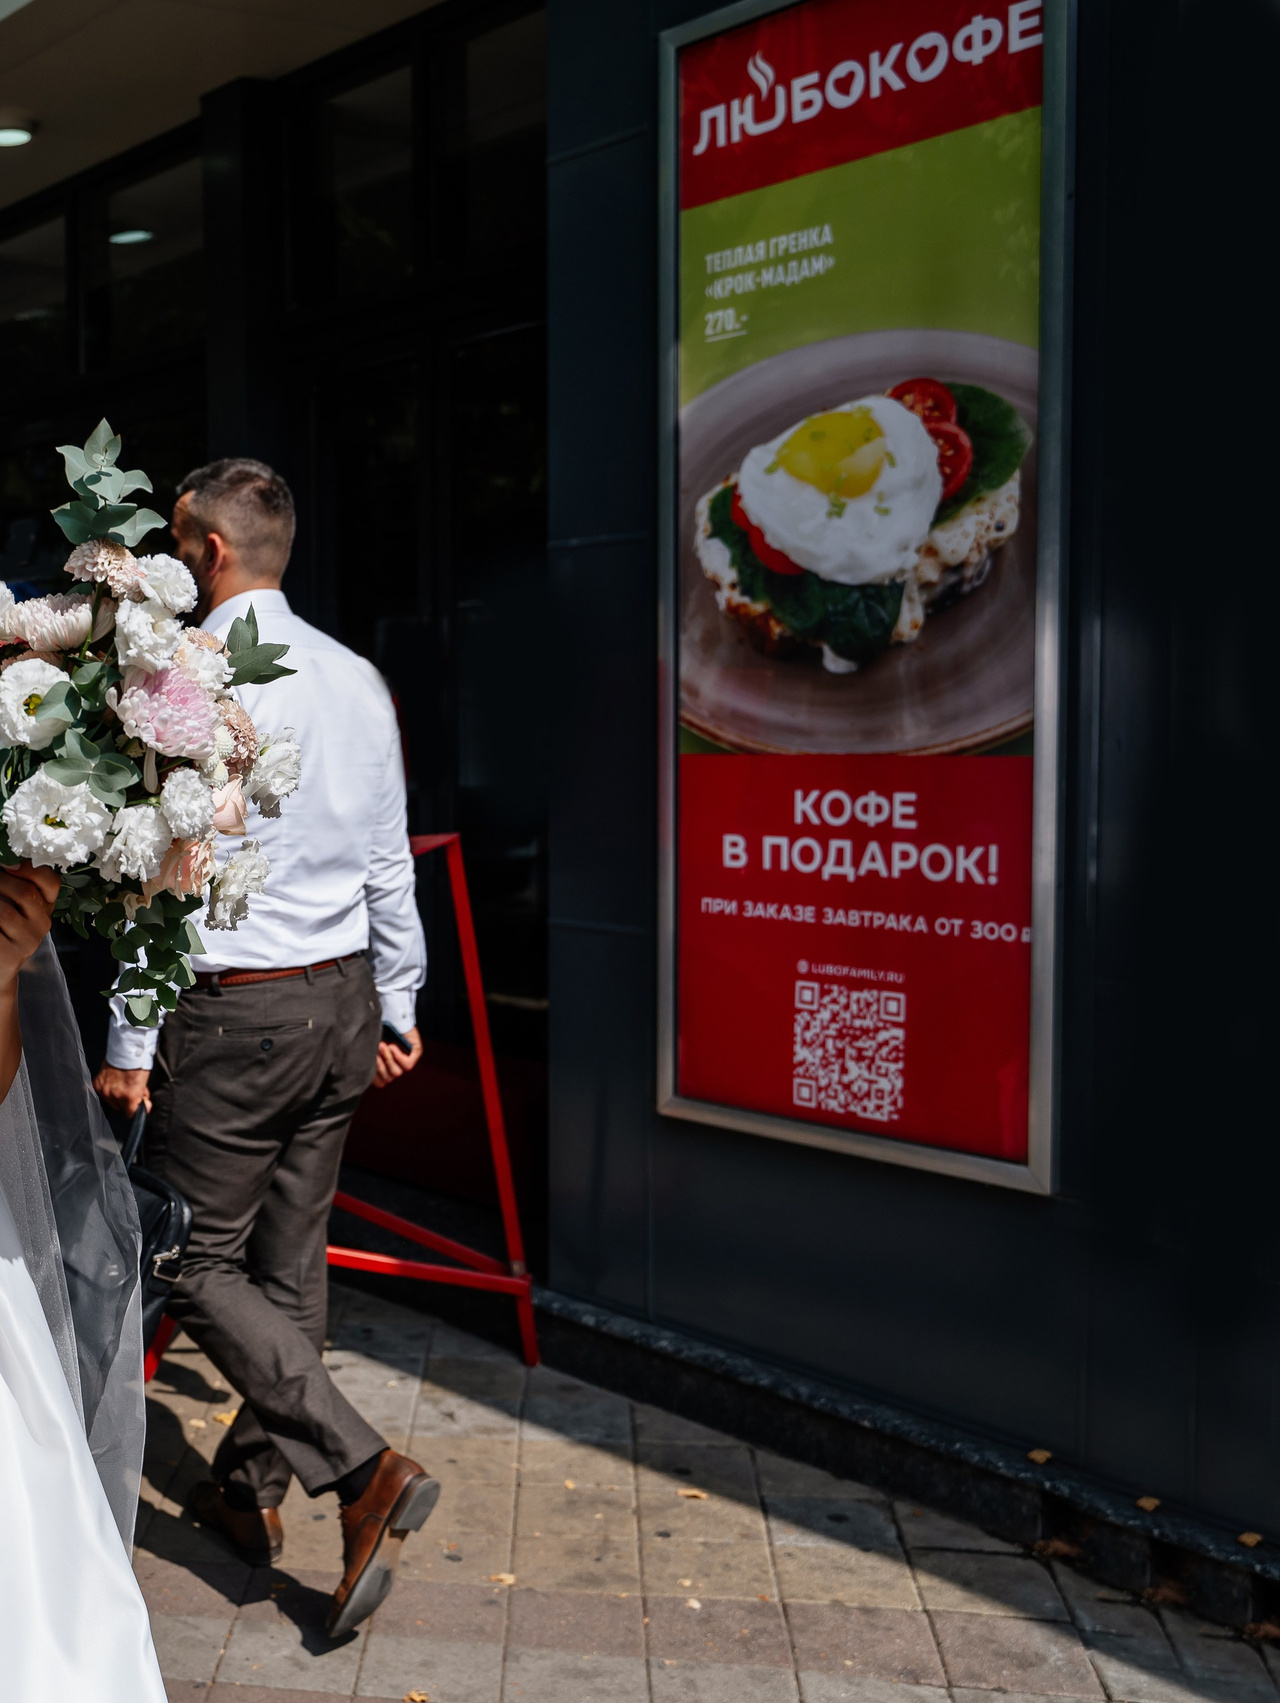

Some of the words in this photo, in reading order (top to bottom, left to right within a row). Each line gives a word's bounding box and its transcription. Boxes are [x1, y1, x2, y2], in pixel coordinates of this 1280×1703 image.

[692, 0, 1043, 156] ЛЮБОКОФЕ
[704, 240, 766, 275] ТЕПЛАЯ
[768, 223, 835, 260] ГРЕНКА
[704, 253, 836, 300] «КРОК-МАДАМ»
[793, 789, 918, 829] КОФЕ
[721, 833, 749, 869] В
[761, 835, 1000, 886] ПОДАРОК!
[700, 896, 739, 917] ПРИ
[742, 900, 817, 924] ЗАКАЗЕ
[821, 907, 929, 934] ЗАВТРАКА
[934, 916, 964, 938] ОТ
[969, 920, 1018, 943] 300
